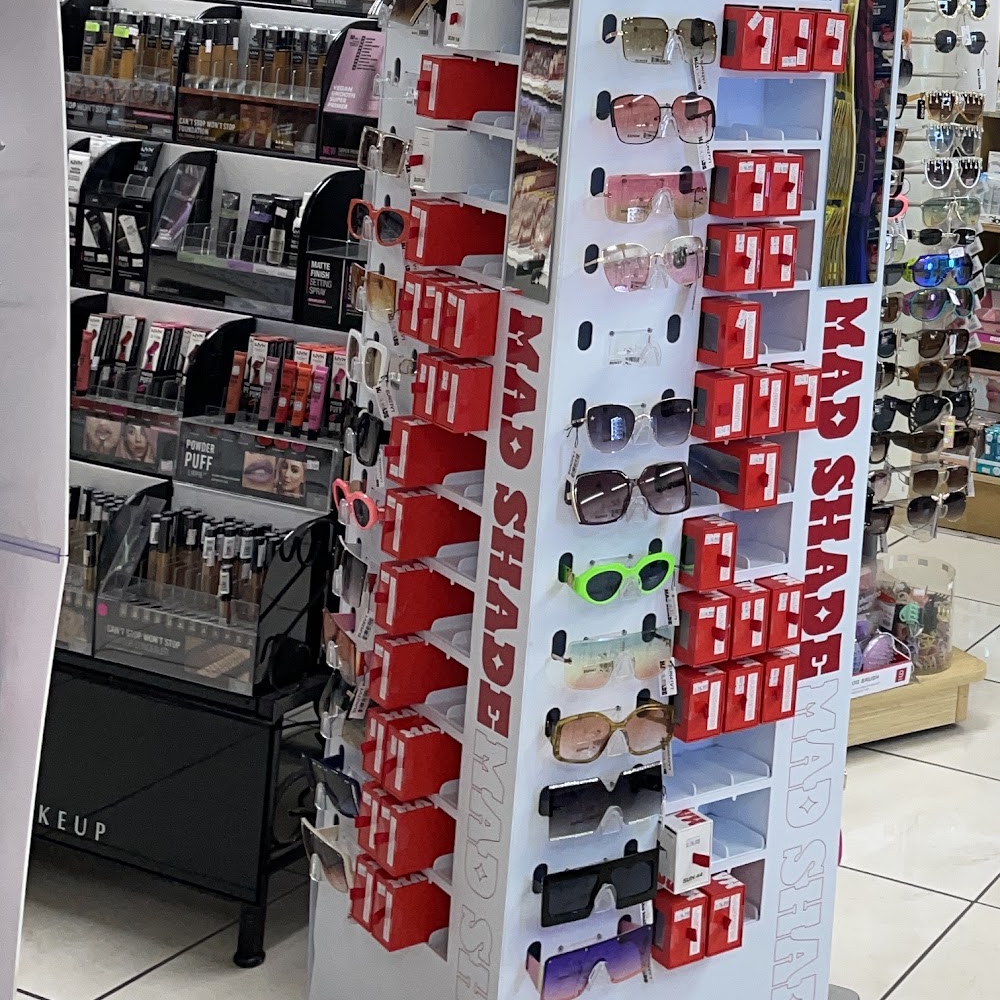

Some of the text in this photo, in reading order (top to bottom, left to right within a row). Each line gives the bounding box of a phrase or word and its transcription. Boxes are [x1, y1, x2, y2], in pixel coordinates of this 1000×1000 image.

[311, 260, 331, 271] MATTE
[310, 269, 331, 280] FINISH
[308, 286, 327, 296] SPRAY
[309, 278, 333, 289] SETTING
[186, 439, 215, 454] POWDER
[184, 452, 213, 471] PUFF
[799, 296, 869, 681] MAD SHADE
[477, 307, 543, 738] MAD SHADE
[38, 803, 107, 843] KEUP
